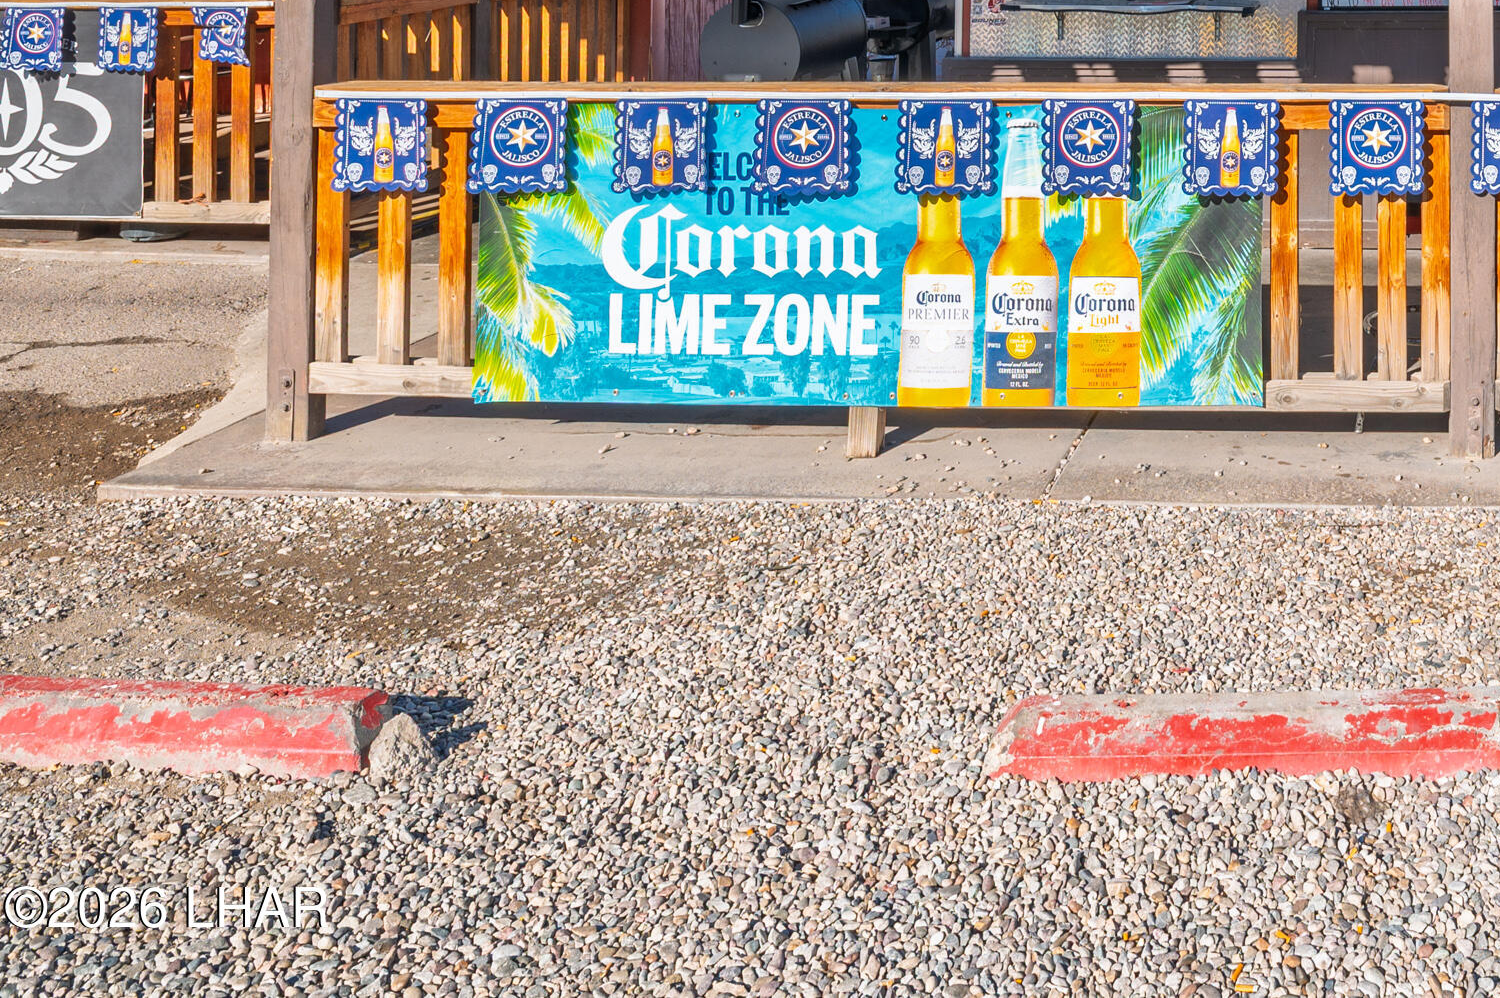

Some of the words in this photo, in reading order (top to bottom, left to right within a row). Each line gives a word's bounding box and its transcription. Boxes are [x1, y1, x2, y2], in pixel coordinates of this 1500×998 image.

[22, 16, 51, 28] ESTRELLA
[0, 62, 112, 156] 05
[500, 111, 545, 129] ESTRELLA
[782, 111, 827, 129] ESTRELLA
[1067, 111, 1112, 130] ESTRELLA
[1354, 112, 1399, 131] ESTRELLA
[502, 149, 540, 162] JALISCO
[785, 150, 822, 163] JALISCO
[1071, 149, 1108, 162] JALISCO
[1358, 151, 1395, 163] JALISCO
[705, 187, 735, 216] TO
[740, 187, 790, 216] THE
[600, 203, 883, 301] Corona
[916, 290, 962, 307] Corona
[992, 292, 1053, 317] Corona
[1074, 293, 1135, 318] Corona
[908, 308, 969, 320] PREMIER
[1006, 312, 1039, 326] Extra
[1090, 314, 1120, 328] Light
[608, 293, 732, 356] LIME
[742, 293, 881, 356] ZONE
[909, 336, 920, 345] 90
